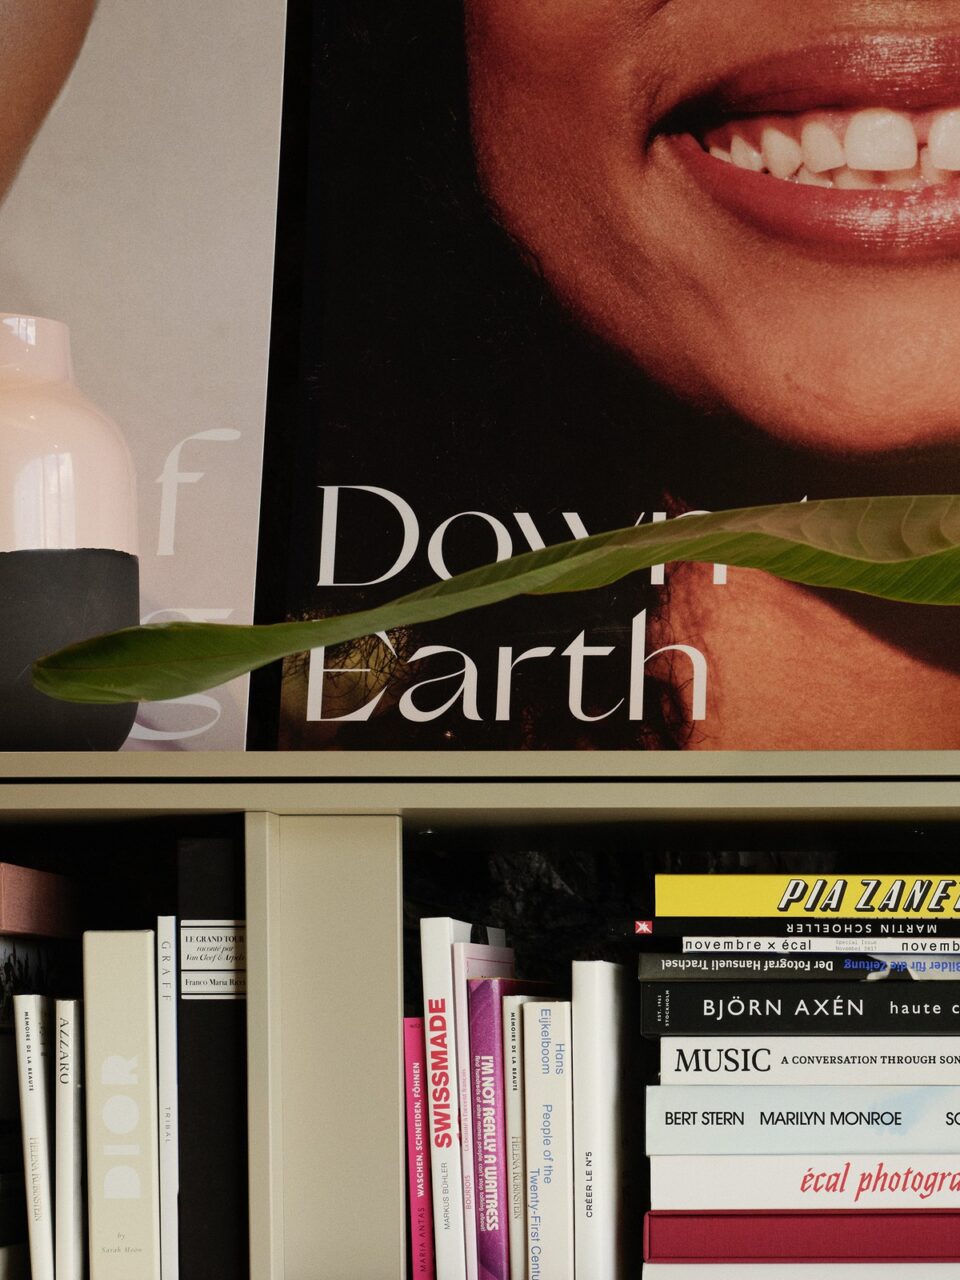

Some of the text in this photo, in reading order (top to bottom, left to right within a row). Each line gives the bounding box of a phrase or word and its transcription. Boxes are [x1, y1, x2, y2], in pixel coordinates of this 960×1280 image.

[306, 608, 706, 722] Earth
[777, 878, 848, 913] PIA
[786, 923, 937, 934] MARTIN SCHOELLER
[685, 939, 762, 951] novembre
[782, 939, 812, 951] écal
[162, 941, 171, 1001] GRAFF
[661, 958, 833, 971] Der Fotograf Hansueli Trachsel
[844, 958, 888, 971] Zeitung
[890, 960, 908, 972] die
[911, 960, 930, 972] für
[703, 996, 864, 1021] BJÖRN AXÉN
[890, 1001, 942, 1014] haute
[60, 1017, 70, 1085] AZZARO
[539, 1008, 551, 1075] Eijkelboom
[428, 998, 453, 1149] SWISSMADE
[556, 1043, 565, 1075] Hans
[674, 1048, 771, 1072] MUSIC
[781, 1055, 789, 1064] A
[792, 1055, 879, 1065] CONVERSATION
[881, 1055, 937, 1065] THROUGH
[102, 1055, 141, 1199] DIOR
[411, 1062, 424, 1198] WASCHEN, SCHNEIDEN, FÖHNEN
[665, 1111, 902, 1126] BERT STERN MARILYN MONROE
[481, 1056, 499, 1231] I'M NOT REALLY A WAITRESS
[541, 1104, 554, 1184] People of the
[800, 1162, 850, 1193] écal
[440, 1162, 450, 1230] MARKUS BÜHLER
[529, 1168, 541, 1242] Twenty-First
[417, 1207, 425, 1238] ANTAS
